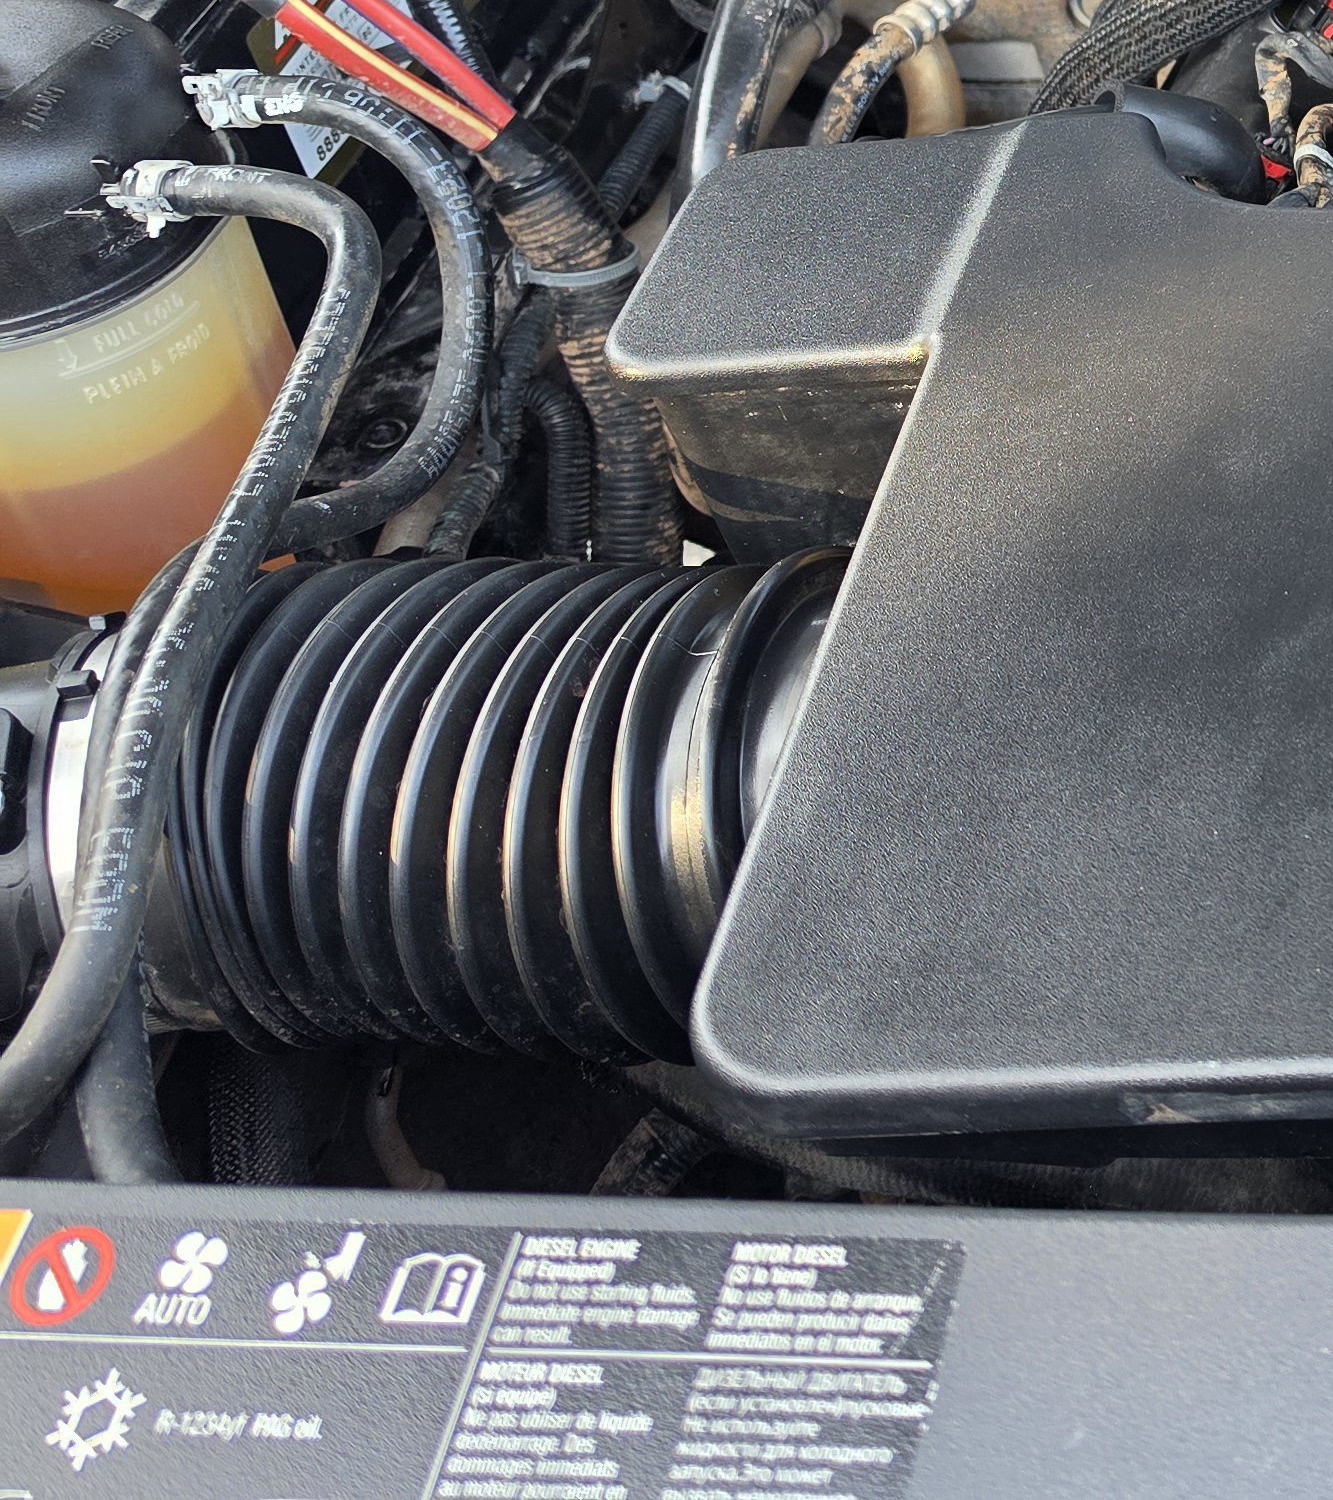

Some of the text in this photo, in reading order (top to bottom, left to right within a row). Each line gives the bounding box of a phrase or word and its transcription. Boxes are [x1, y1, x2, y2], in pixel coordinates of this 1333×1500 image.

[92, 320, 142, 352] FULL
[520, 1236, 642, 1261] DIESEL ENGINE
[733, 1241, 848, 1267] MOTOR DIESEL
[531, 1282, 558, 1299] not
[559, 1284, 588, 1300] use
[746, 1289, 774, 1307] use
[829, 1289, 850, 1308] de
[134, 1294, 211, 1325] AUTO
[582, 1306, 635, 1328] engine
[635, 1306, 700, 1332] damage
[736, 1308, 794, 1331] pueden
[795, 1311, 861, 1333] producir
[491, 1326, 522, 1344] can
[793, 1334, 815, 1352] en
